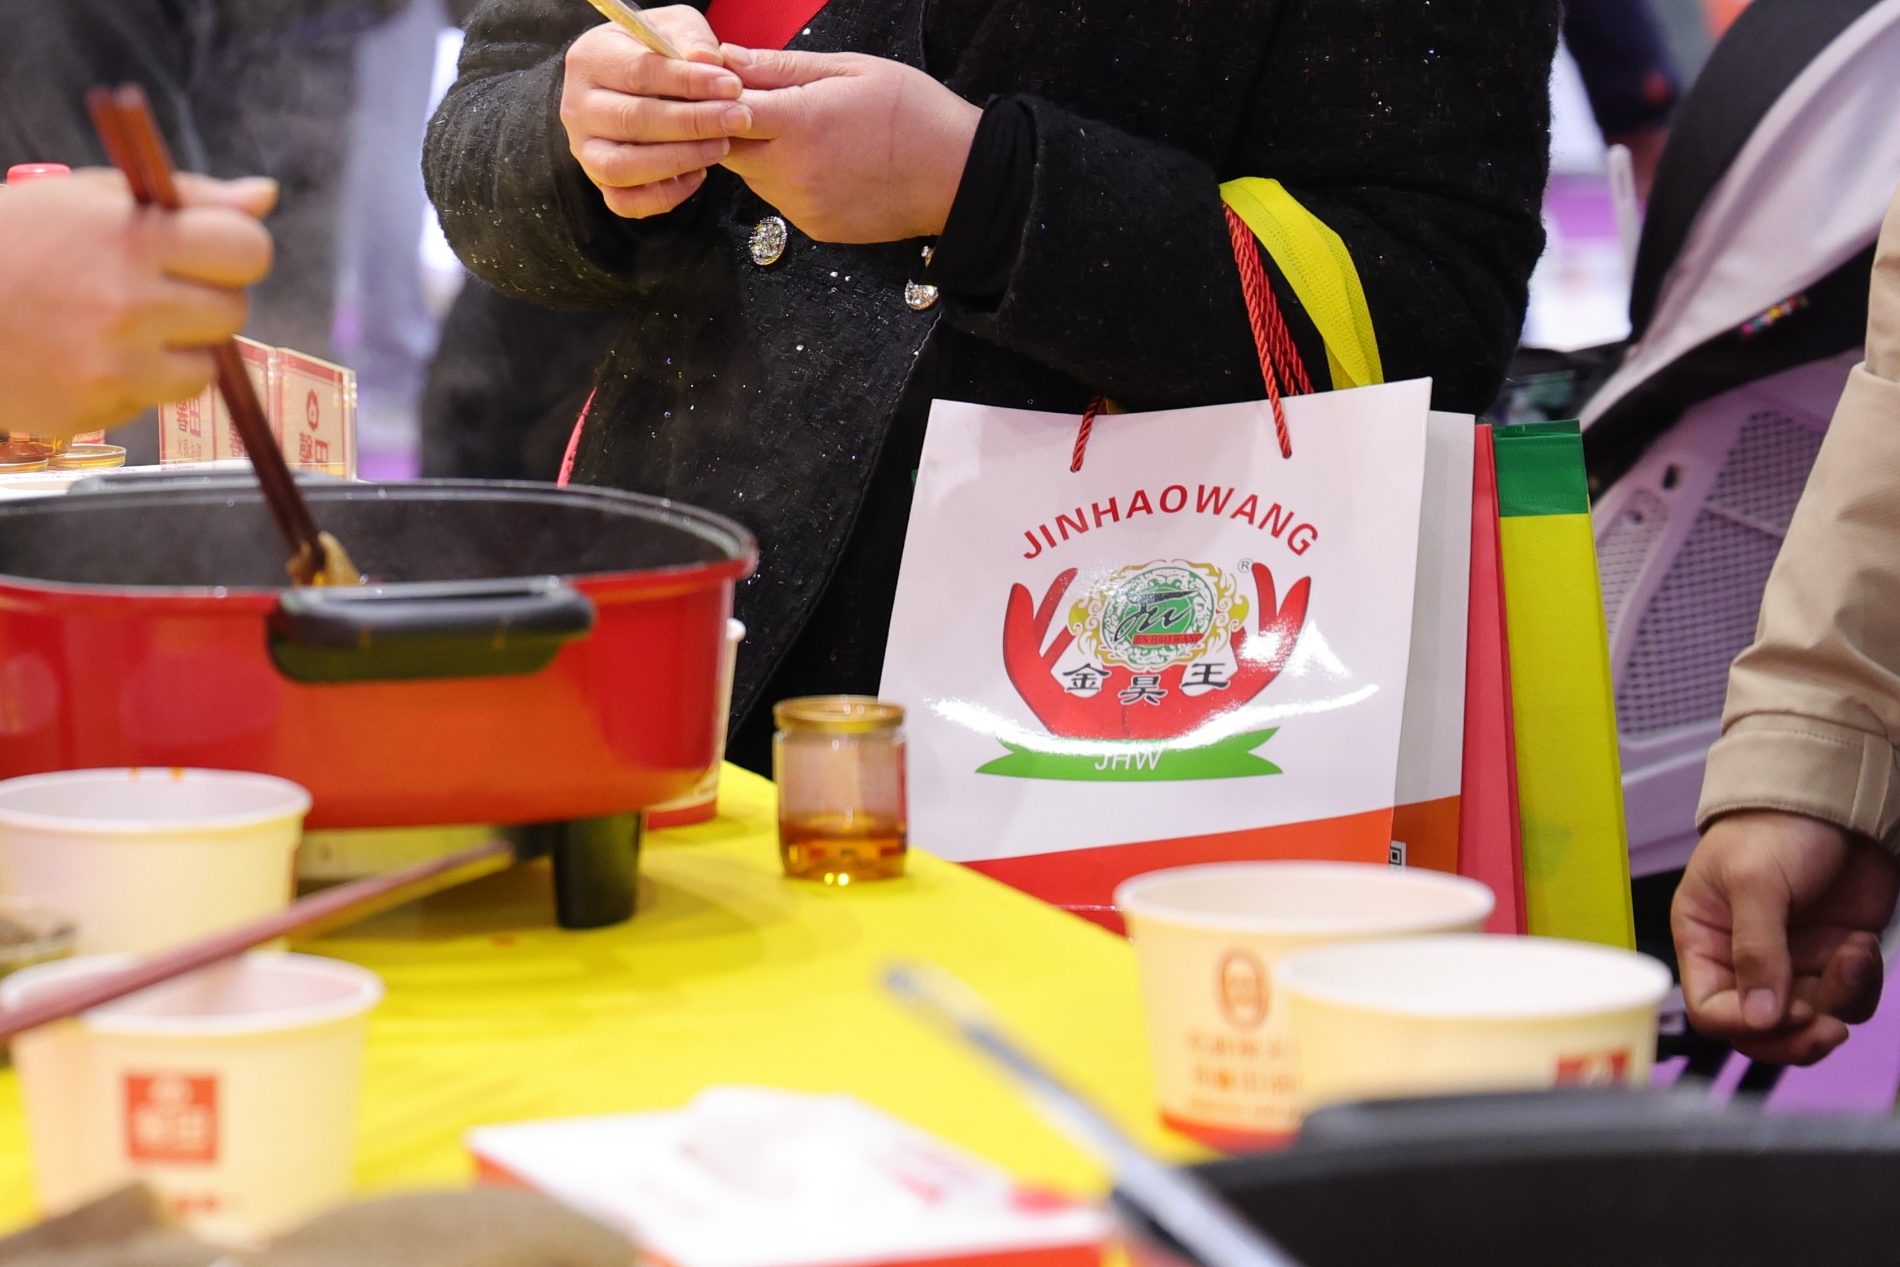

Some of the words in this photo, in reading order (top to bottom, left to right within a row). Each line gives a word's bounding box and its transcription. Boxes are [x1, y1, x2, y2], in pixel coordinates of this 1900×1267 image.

[1023, 484, 1319, 560] JINHAOWANG
[1062, 663, 1231, 705] 金昊王
